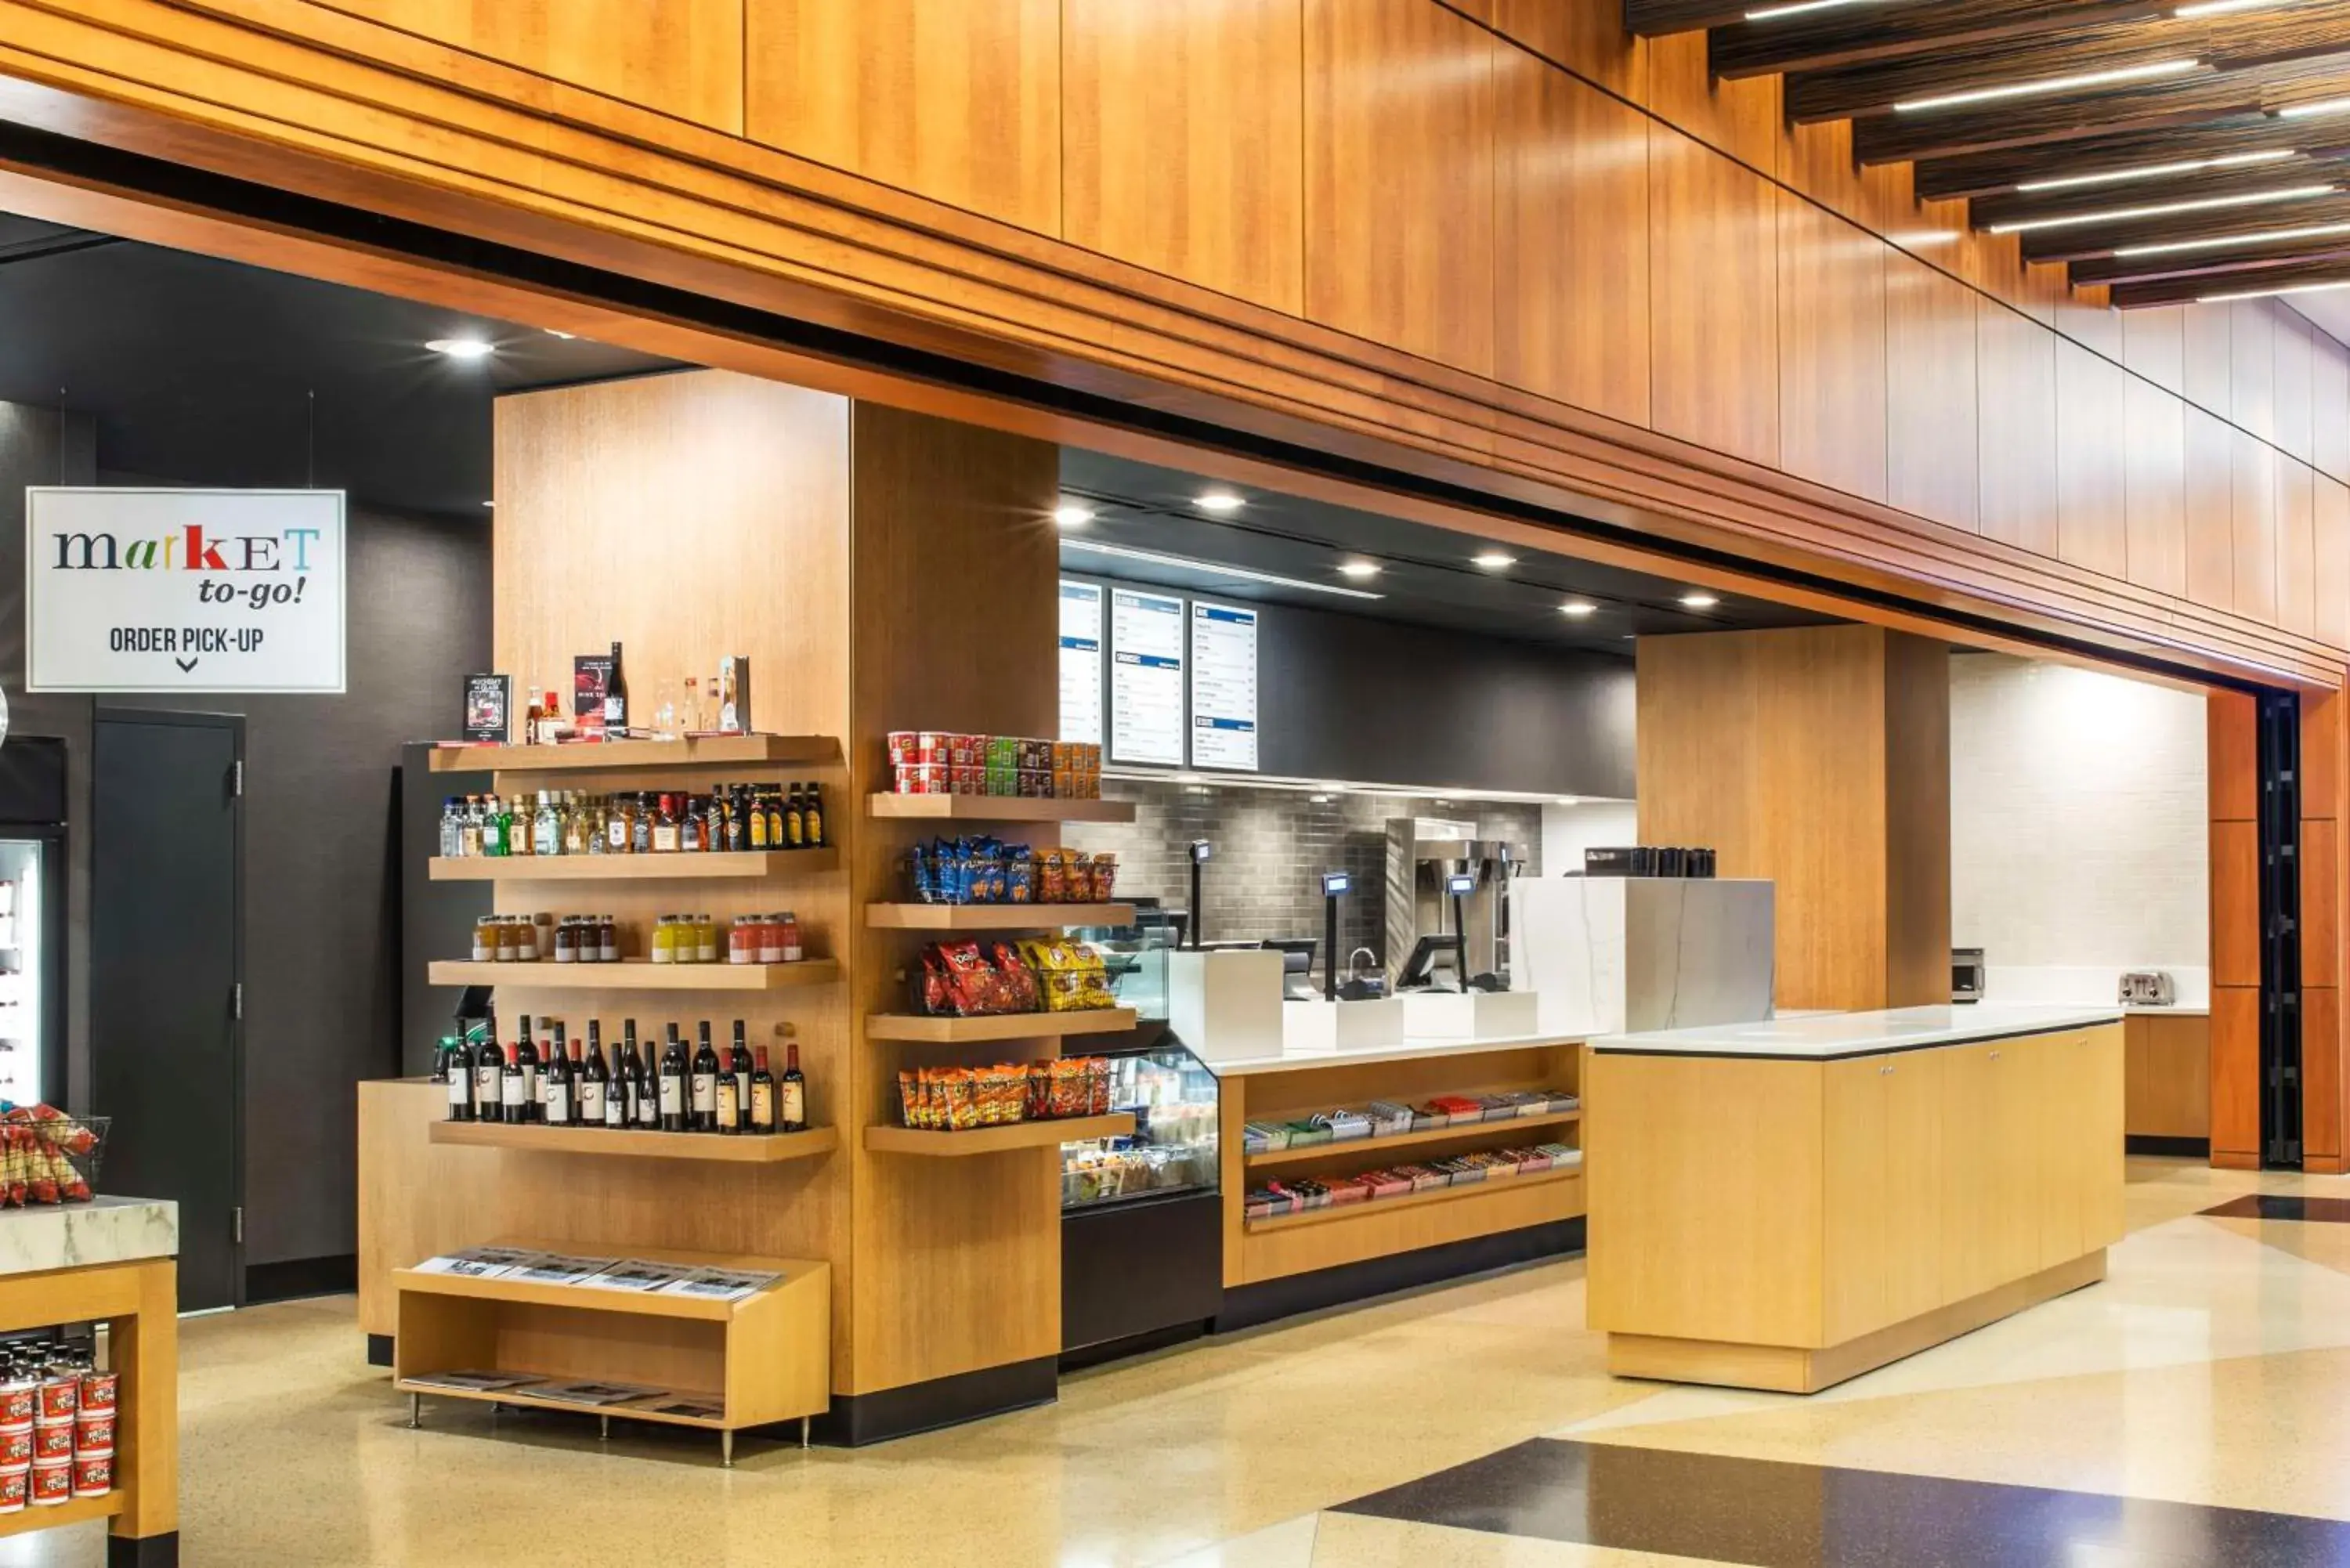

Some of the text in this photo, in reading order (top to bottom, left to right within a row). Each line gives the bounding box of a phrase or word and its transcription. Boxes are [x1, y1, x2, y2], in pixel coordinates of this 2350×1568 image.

[199, 576, 306, 609] to-go!
[110, 627, 264, 652] ORDER PICK-UP
